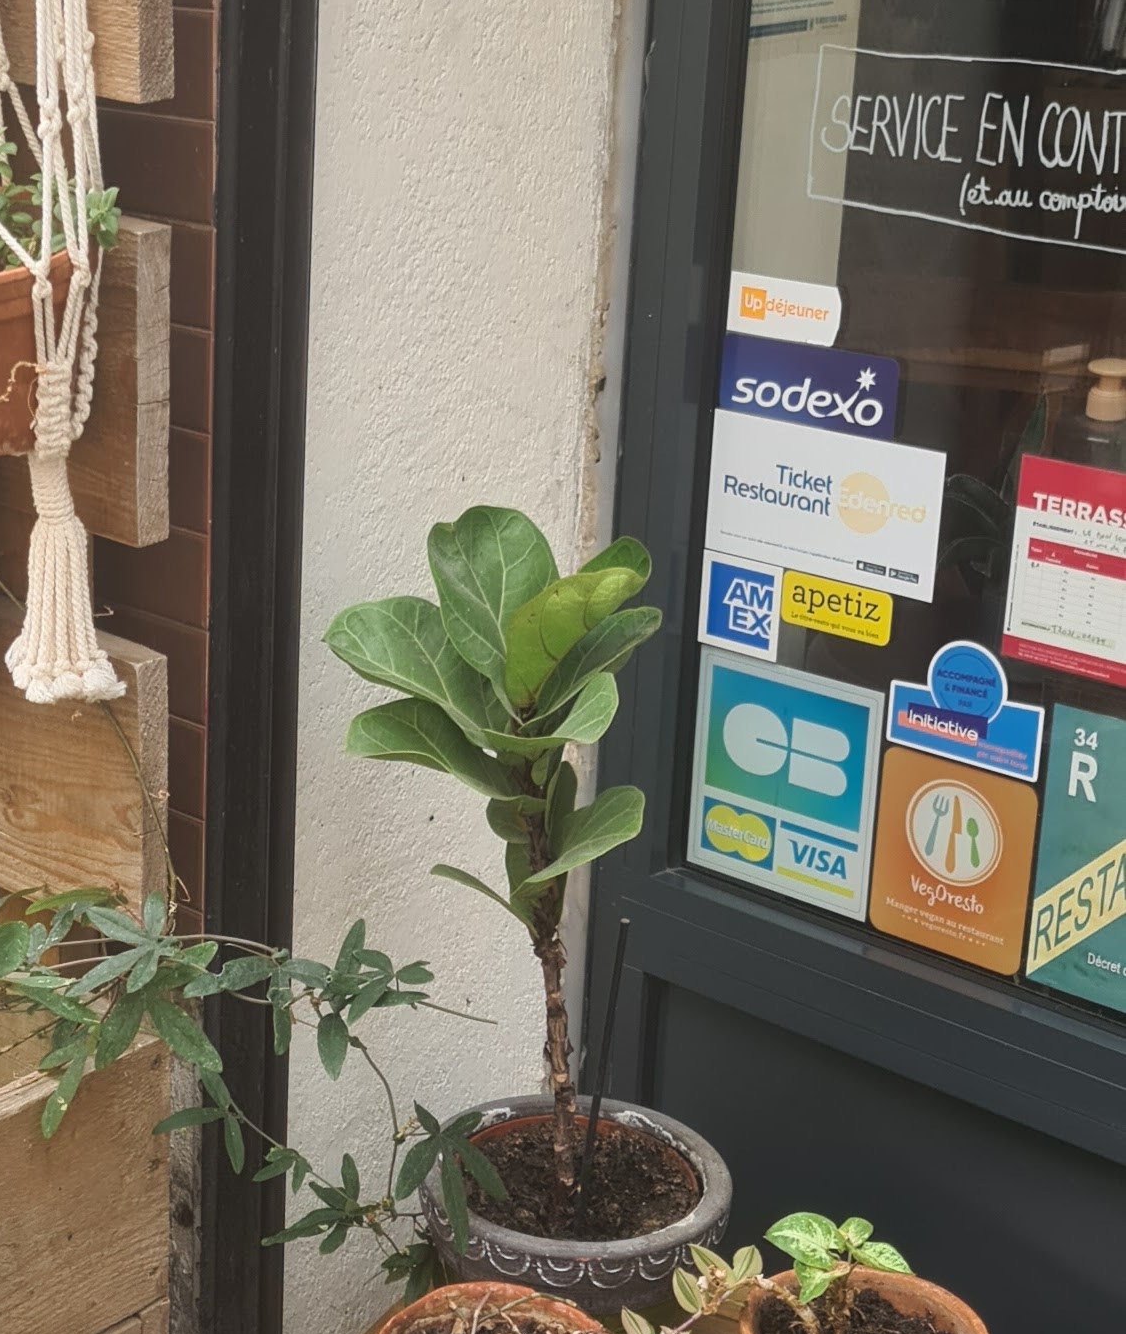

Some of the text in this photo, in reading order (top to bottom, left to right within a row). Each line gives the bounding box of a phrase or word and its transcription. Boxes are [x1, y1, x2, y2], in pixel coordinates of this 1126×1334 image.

[820, 91, 966, 163] SERVICE
[975, 92, 1030, 167] EN
[744, 292, 830, 321] Up déjeuner
[731, 375, 883, 427] sodexo
[724, 474, 831, 517] Restaurant
[776, 464, 833, 496] Ticket
[838, 483, 927, 524] Edenred
[1033, 492, 1126, 529] TERRAS
[725, 579, 774, 612] AM
[792, 584, 881, 622] apetiz
[729, 605, 772, 638] EX
[908, 710, 979, 741] Initiative
[1074, 727, 1099, 751] 34
[1068, 751, 1098, 803] R
[708, 819, 769, 849] MasterCard
[788, 839, 847, 880] VISA
[910, 874, 984, 915] VegOresto
[886, 897, 1004, 945] Manger vegan au restaurant
[1087, 952, 1121, 975] Décret
